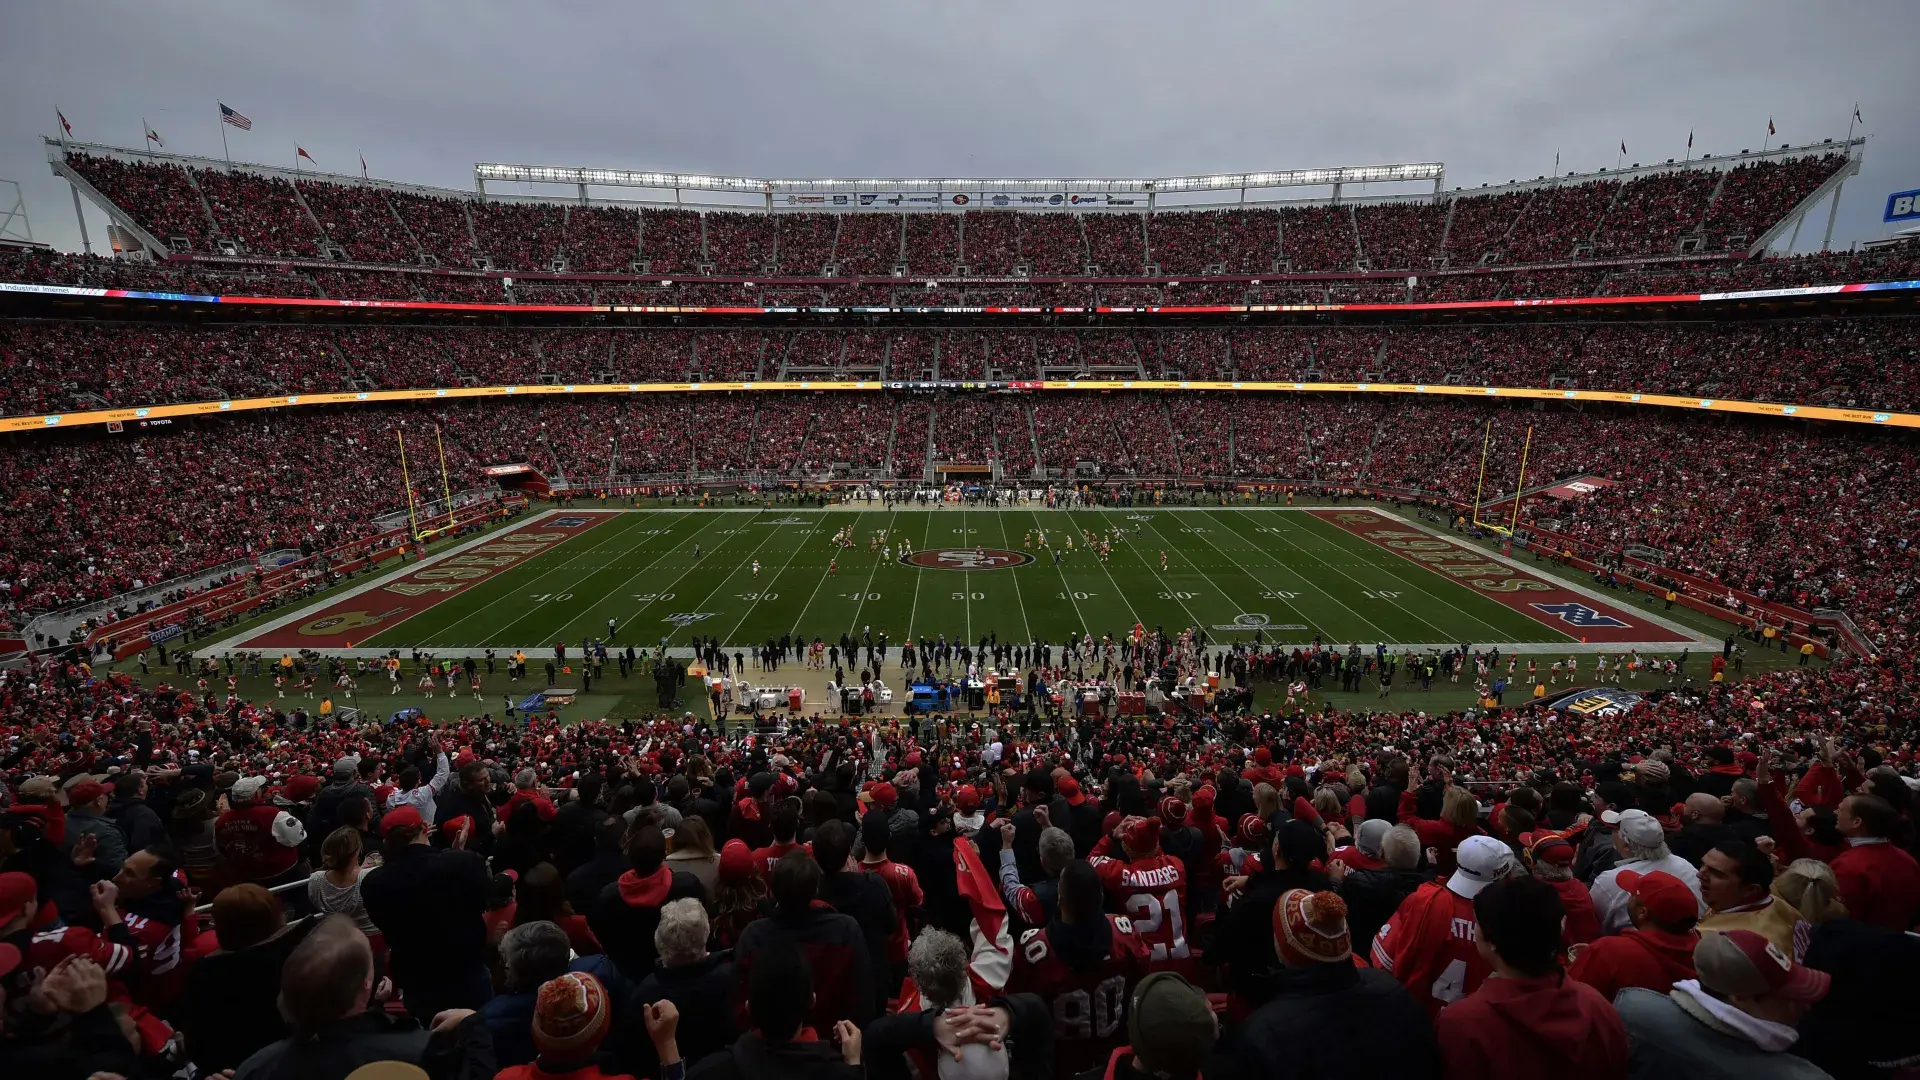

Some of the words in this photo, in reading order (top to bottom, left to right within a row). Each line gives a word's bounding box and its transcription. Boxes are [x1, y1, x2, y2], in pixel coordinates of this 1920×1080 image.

[860, 196, 874, 204] SAP
[887, 198, 899, 207] nrg
[42, 286, 69, 294] Internet
[1783, 287, 1807, 295] Internet
[535, 593, 574, 602] 10
[637, 593, 676, 601] 20
[742, 592, 779, 601] 30
[848, 592, 882, 601] 40
[951, 592, 985, 601] 50
[1055, 592, 1089, 601] 40
[1156, 591, 1192, 600] 30
[1258, 591, 1295, 600] 20
[1361, 590, 1398, 599] 10
[1121, 864, 1179, 889] SANDERS
[1126, 889, 1190, 963] 21
